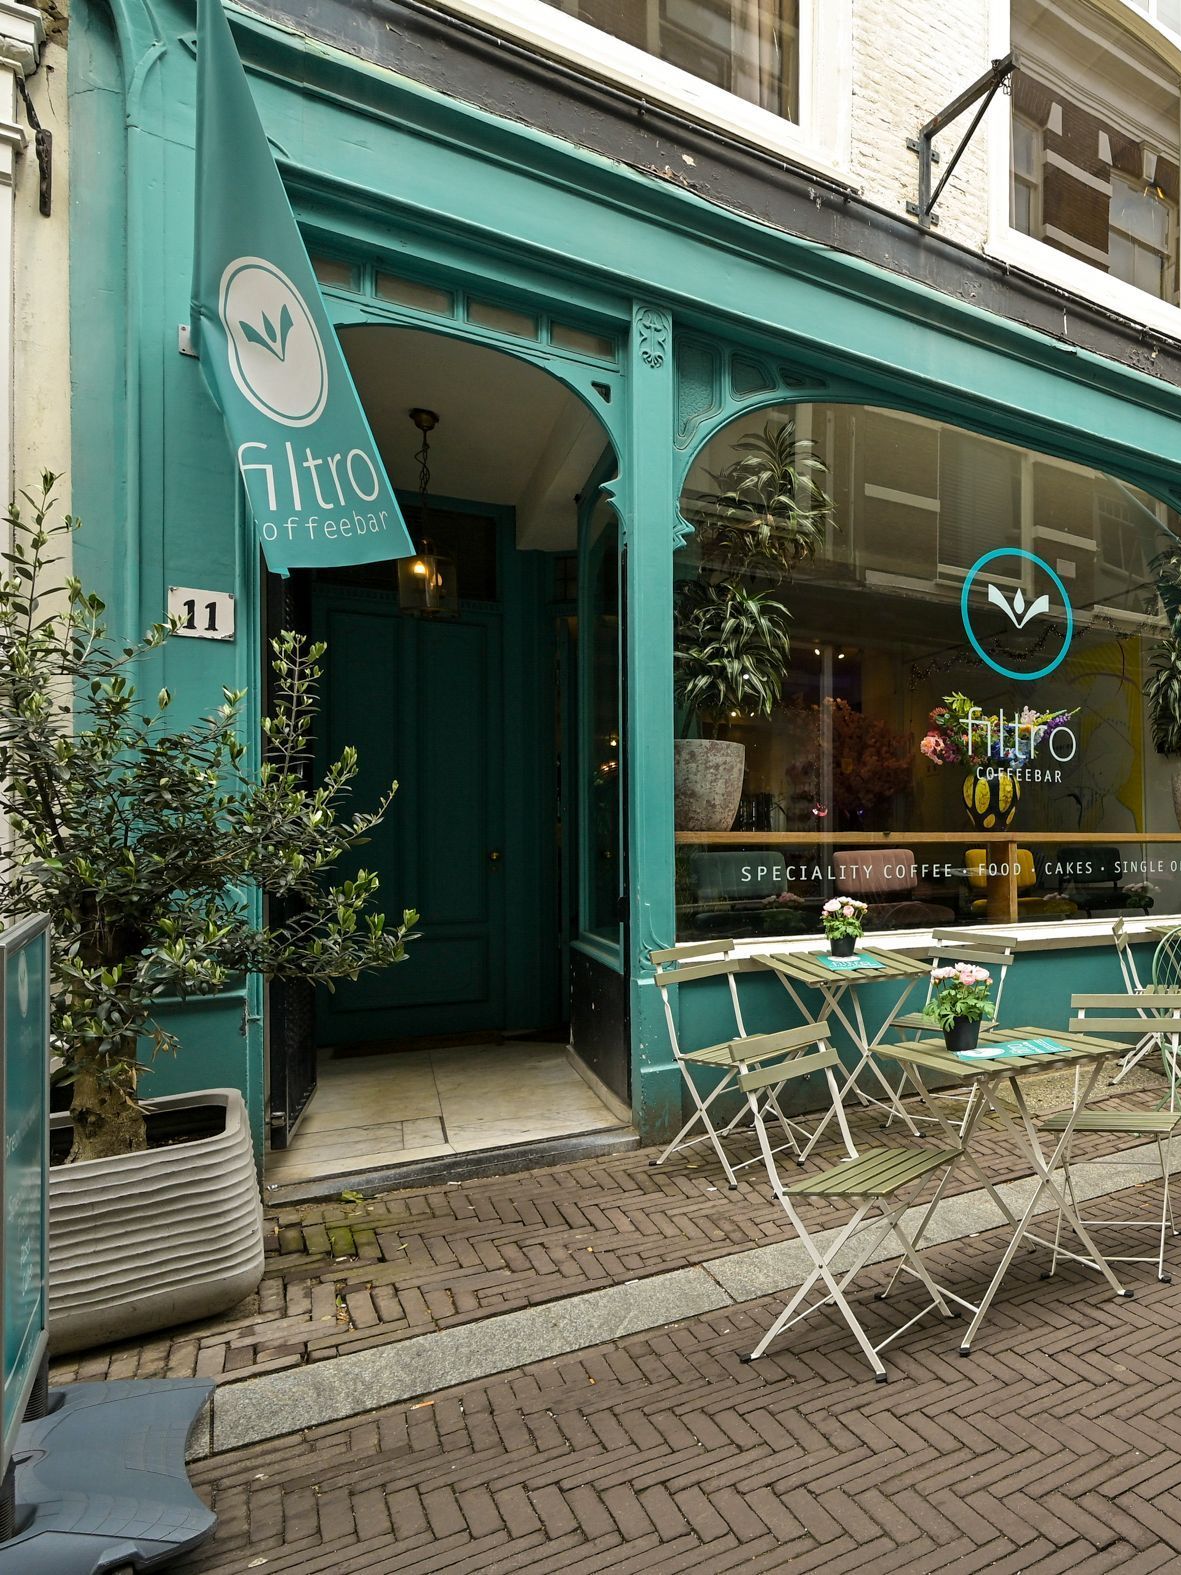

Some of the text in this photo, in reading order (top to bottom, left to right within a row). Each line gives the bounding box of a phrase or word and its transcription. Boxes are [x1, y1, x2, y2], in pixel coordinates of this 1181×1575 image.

[237, 441, 379, 511] filtro
[255, 511, 388, 541] offeebar
[183, 600, 218, 632] 11
[959, 707, 1076, 762] filtro
[976, 766, 1062, 783] COFFEEBAR
[741, 865, 872, 882] SPECIALITY
[884, 863, 952, 878] COFFEE
[978, 863, 1021, 876] FOOD
[1045, 861, 1093, 875] CAKES
[1114, 860, 1164, 873] SINGLE
